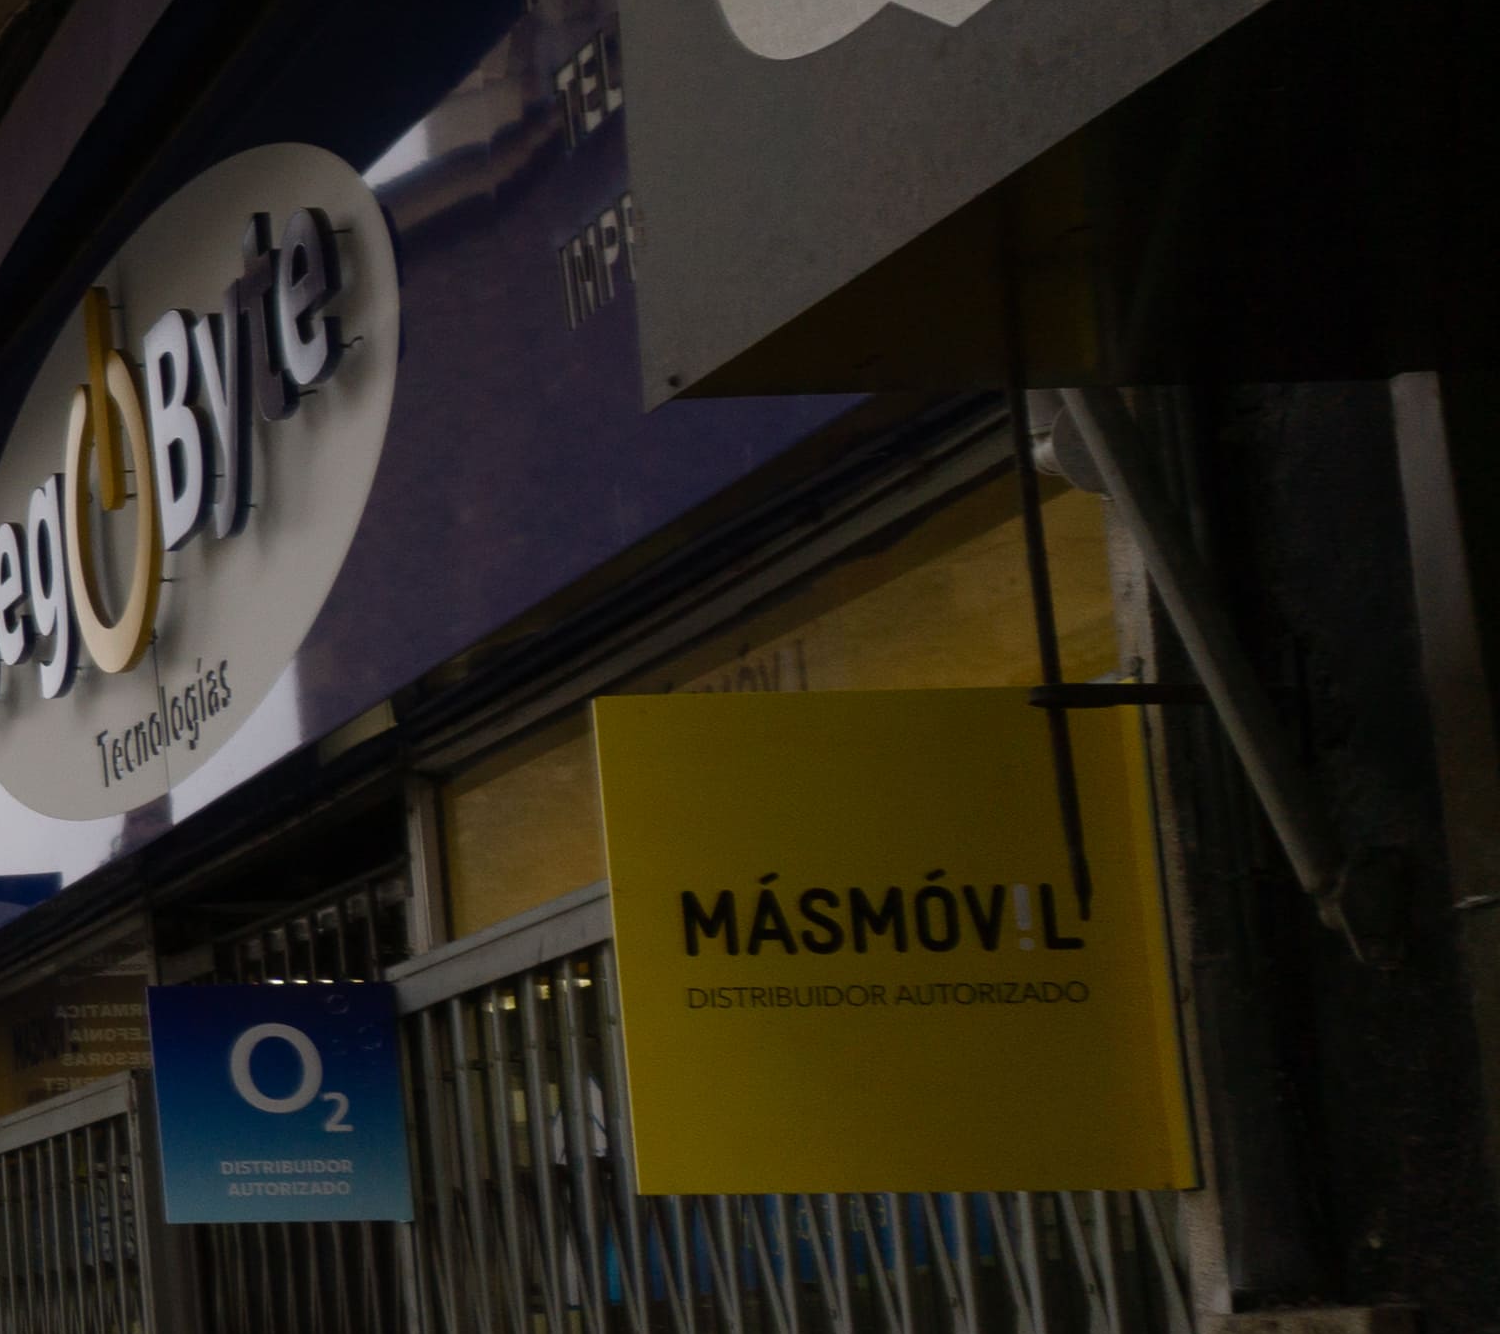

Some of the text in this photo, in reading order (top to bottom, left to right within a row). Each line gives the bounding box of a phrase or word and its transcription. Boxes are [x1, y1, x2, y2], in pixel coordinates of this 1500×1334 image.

[97, 657, 233, 789] Tecnologías
[687, 980, 1091, 1010] DISTRIBUIDOR AUTORIZADO
[220, 1158, 354, 1176] DISTRIBUIDOR
[227, 1180, 351, 1197] AUTORIZADO
